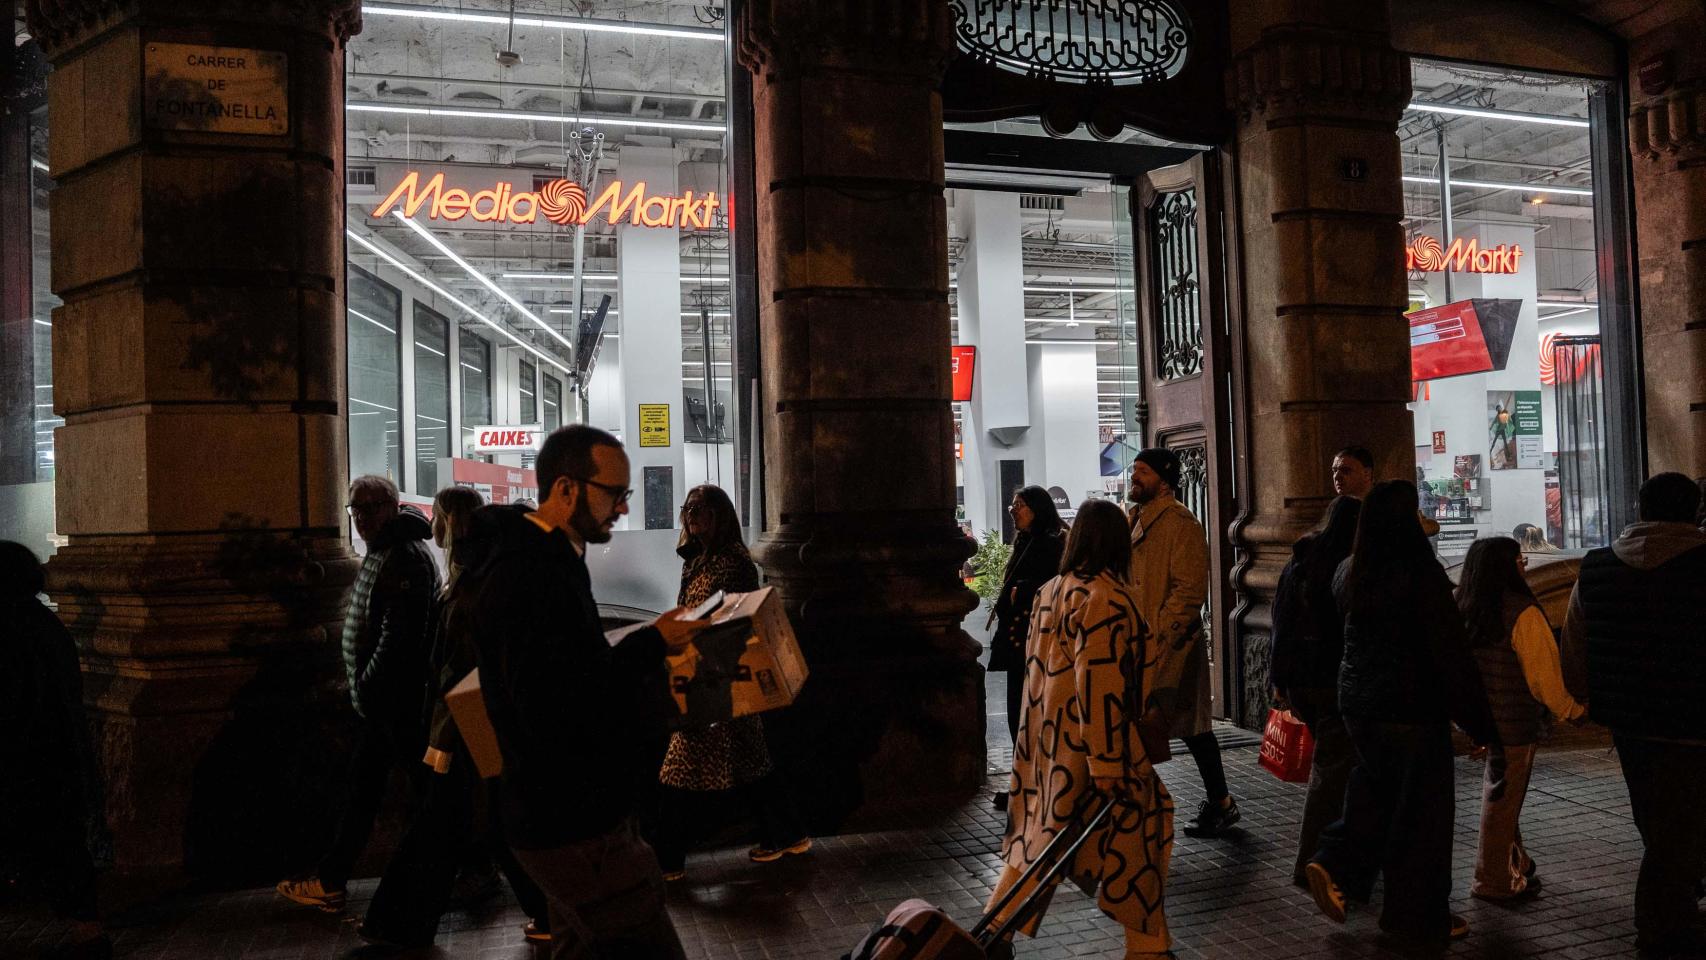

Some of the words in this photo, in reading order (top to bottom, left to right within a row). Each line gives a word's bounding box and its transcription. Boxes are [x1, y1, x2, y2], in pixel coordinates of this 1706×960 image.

[187, 54, 246, 69] CARRER
[208, 79, 226, 91] DE
[156, 100, 277, 120] FONTANELLA
[373, 171, 539, 223] Media
[580, 180, 720, 228] Markt
[1440, 239, 1522, 273] Markt
[480, 431, 533, 446] CAIXES
[1266, 722, 1287, 748] MINI
